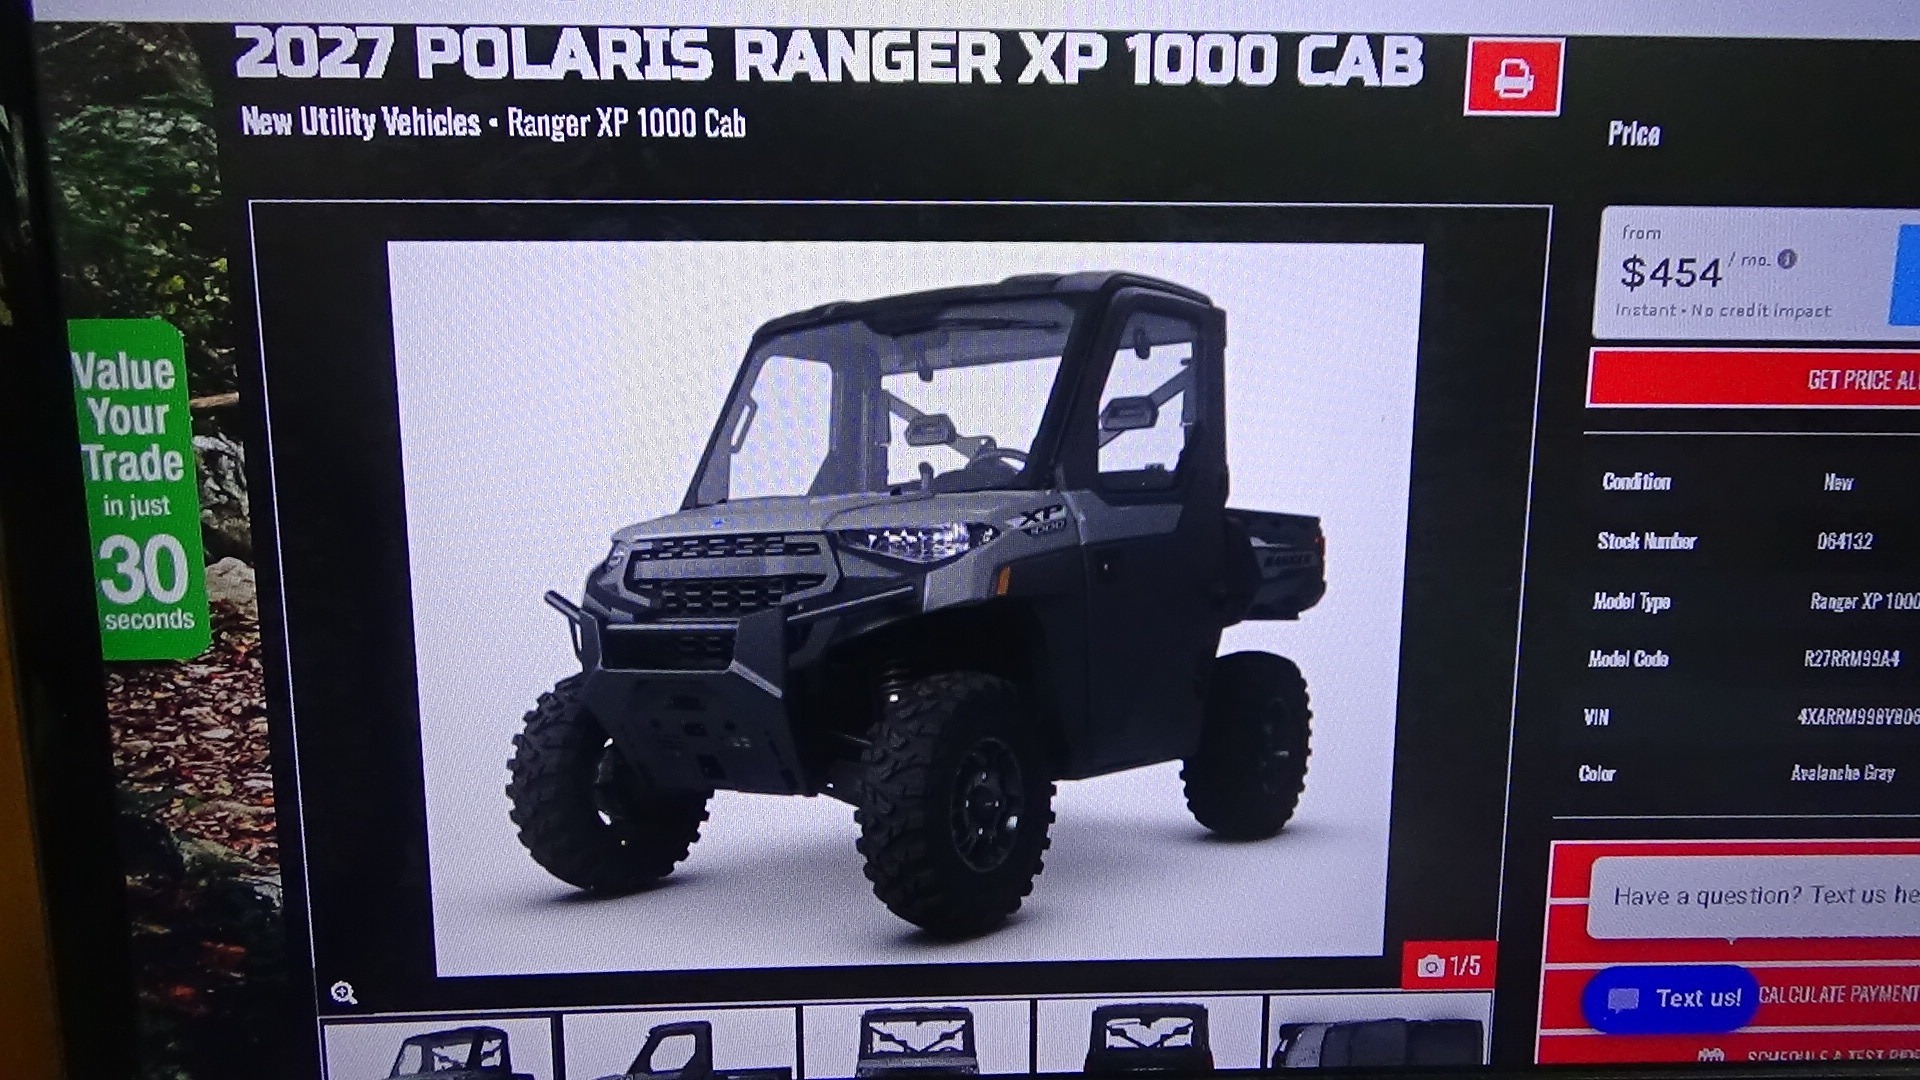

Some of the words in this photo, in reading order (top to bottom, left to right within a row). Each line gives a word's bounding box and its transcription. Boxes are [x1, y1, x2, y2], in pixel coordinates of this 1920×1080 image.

[235, 26, 395, 79] 2027
[417, 26, 713, 82] POLARIS
[734, 28, 1001, 84] RANGER
[1018, 31, 1107, 85] XP
[1127, 33, 1278, 87] 1000
[1297, 34, 1425, 88] CAB
[242, 106, 292, 136] New
[301, 106, 375, 141] Utility
[381, 106, 481, 138] Vehicles
[508, 108, 588, 142] Ranger
[596, 109, 628, 138] XP
[637, 110, 697, 138] 1000
[705, 110, 747, 138] Cab
[1608, 120, 1661, 147] Price
[1622, 225, 1662, 240] from
[1621, 254, 1723, 292] $454
[1616, 303, 1677, 317] Instant
[1692, 304, 1714, 317] No
[1720, 303, 1769, 317] credit
[1774, 304, 1834, 321] impact
[71, 352, 175, 390] Value
[1808, 369, 1841, 390] GET
[1844, 370, 1893, 390] PRICE
[1896, 370, 1920, 390] AL
[87, 397, 170, 435] Your
[81, 444, 184, 481] Trade
[1603, 472, 1672, 491] Condition
[1824, 473, 1855, 491] New
[104, 494, 124, 516] in
[130, 495, 171, 521] just
[1598, 532, 1640, 550] Stock
[1644, 533, 1698, 550] Number
[1817, 533, 1874, 550] 064132
[100, 534, 189, 604] 30
[1593, 592, 1635, 610] Model
[1640, 592, 1672, 614] Type
[1810, 592, 1859, 612] Ranger
[1861, 592, 1883, 610] XP
[1886, 592, 1920, 610] 1000
[105, 609, 195, 631] seconds
[1588, 650, 1629, 668] Model
[1633, 650, 1670, 668] Code
[1584, 708, 1610, 726] VIN
[1578, 764, 1617, 782] Color
[1791, 763, 1861, 781] Avalanche
[1864, 763, 1896, 783] Gray
[1614, 887, 1669, 906] Have
[1677, 890, 1690, 905] a
[1697, 886, 1802, 909] question?
[1811, 885, 1856, 904] Text
[1861, 888, 1886, 903] us
[1450, 955, 1481, 976] 1/5
[1656, 988, 1703, 1007] Text
[1710, 987, 1742, 1007] us!
[1758, 986, 1846, 1004] CALCULATE
